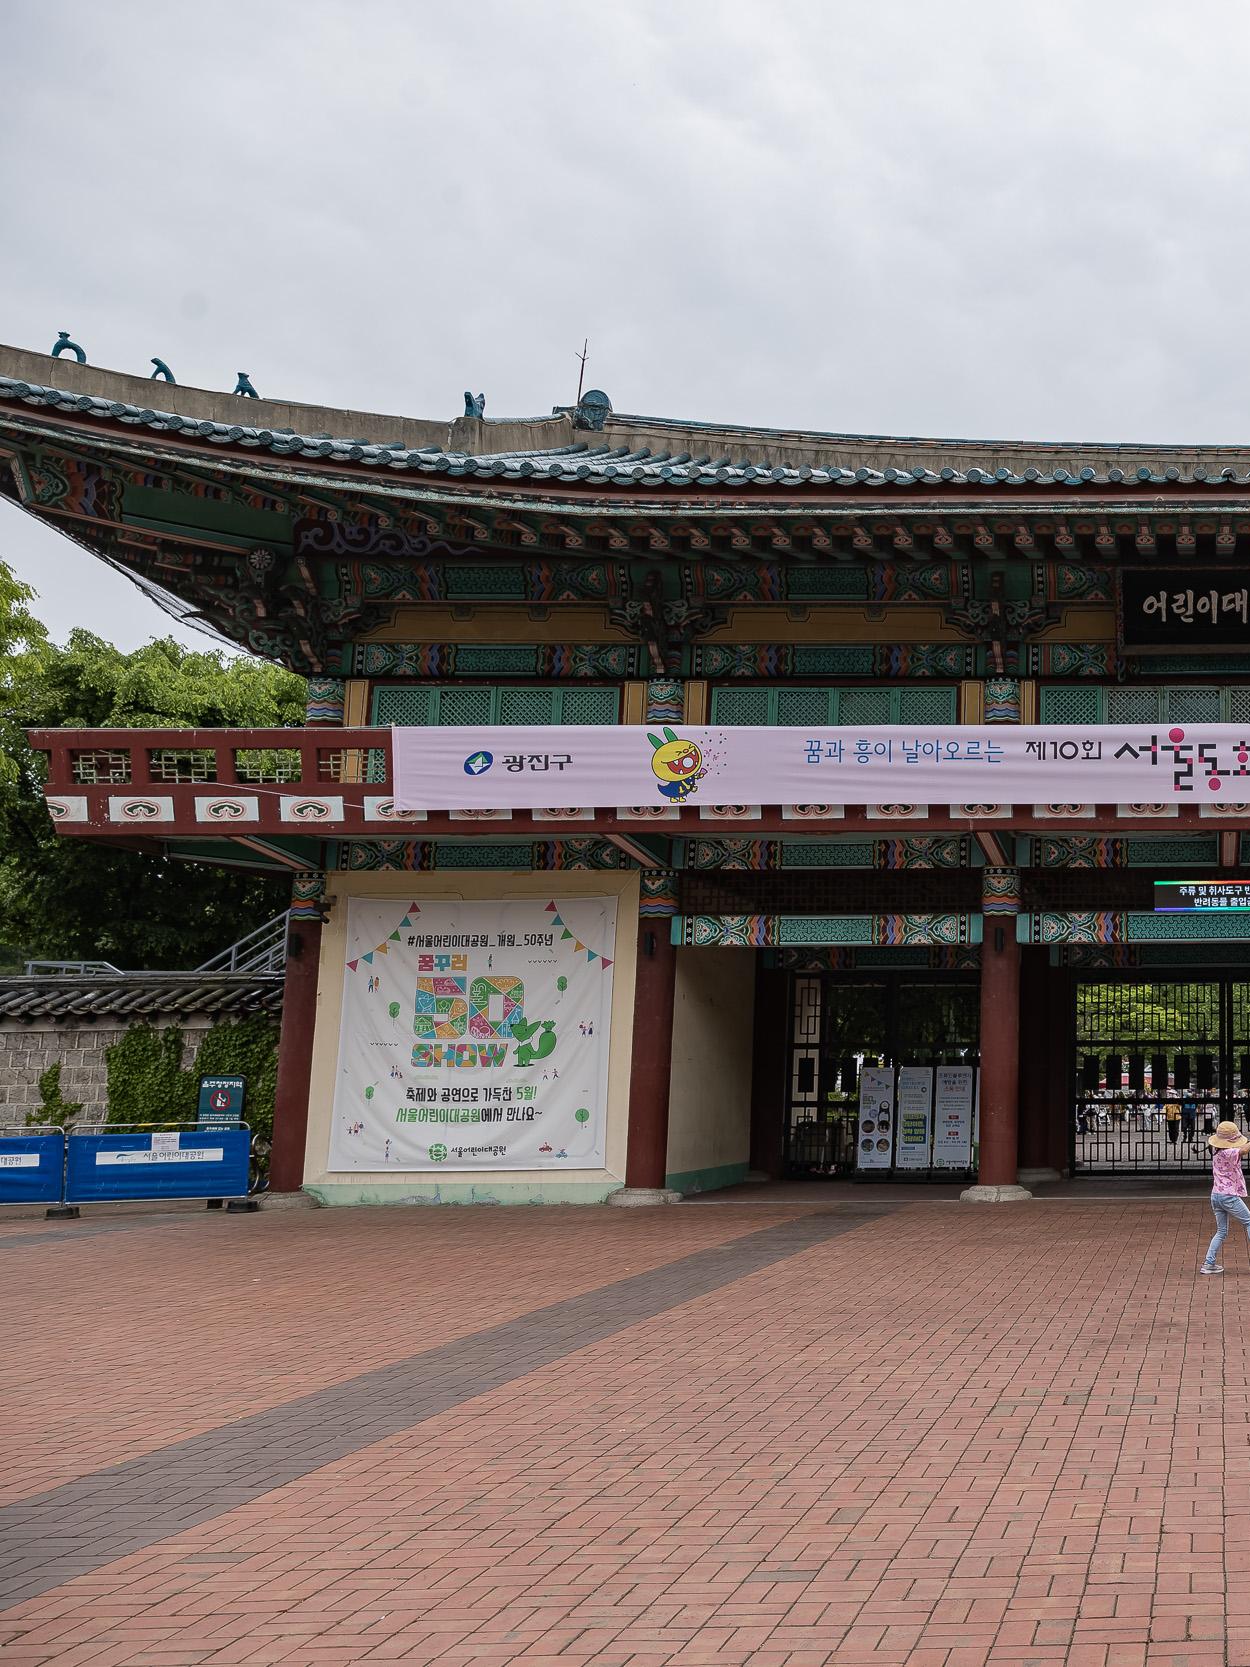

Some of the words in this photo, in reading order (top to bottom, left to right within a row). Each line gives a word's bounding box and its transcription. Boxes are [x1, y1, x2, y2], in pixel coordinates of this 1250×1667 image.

[803, 739, 845, 763] 꿈과
[853, 739, 892, 763] 흥이
[902, 739, 1004, 763] 날아오르는
[1026, 740, 1102, 760] 제10회
[501, 754, 573, 772] 광진구
[1179, 886, 1196, 896] 주류
[1198, 886, 1207, 896] 및
[1208, 885, 1242, 896] 취사도구
[1194, 897, 1228, 907] 반려동물
[413, 976, 524, 1040] 50
[411, 1043, 509, 1067] SHOW
[406, 1087, 437, 1102] 축제와
[440, 1087, 478, 1102] 공연으로
[482, 1086, 512, 1102] 가득찬
[516, 1086, 537, 1101] 5월!
[395, 1107, 503, 1122] 서울어린이대공원에서
[506, 1106, 543, 1121] 만나요~
[143, 1151, 205, 1162] 서울어린이대공원
[450, 1145, 507, 1157] 서울어린이대공원
